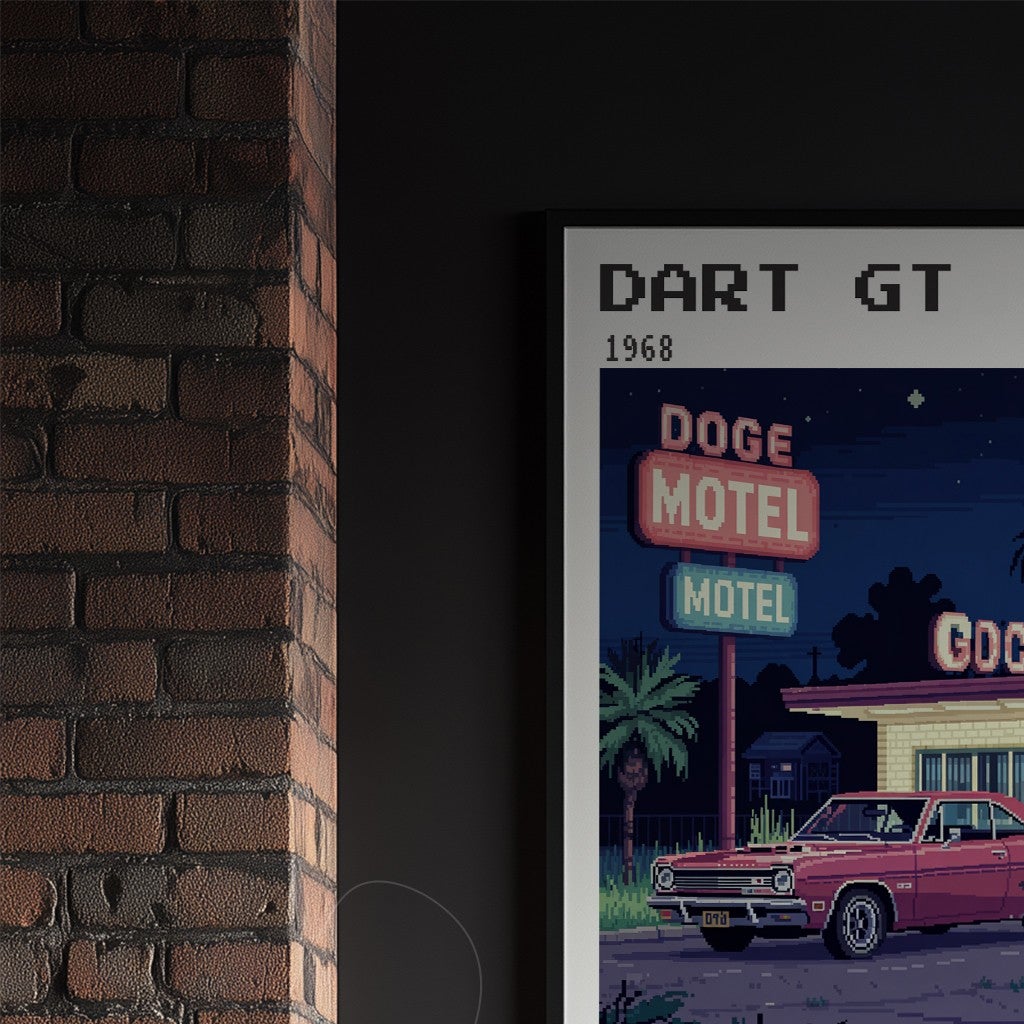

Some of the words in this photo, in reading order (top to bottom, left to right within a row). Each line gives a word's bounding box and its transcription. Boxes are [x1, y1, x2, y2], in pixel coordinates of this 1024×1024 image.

[599, 263, 799, 312] DART
[854, 263, 952, 312] GT
[606, 334, 673, 362] 1968
[660, 402, 794, 468] DOGE
[651, 467, 810, 543] MOTEL
[683, 575, 790, 625] MOTEL
